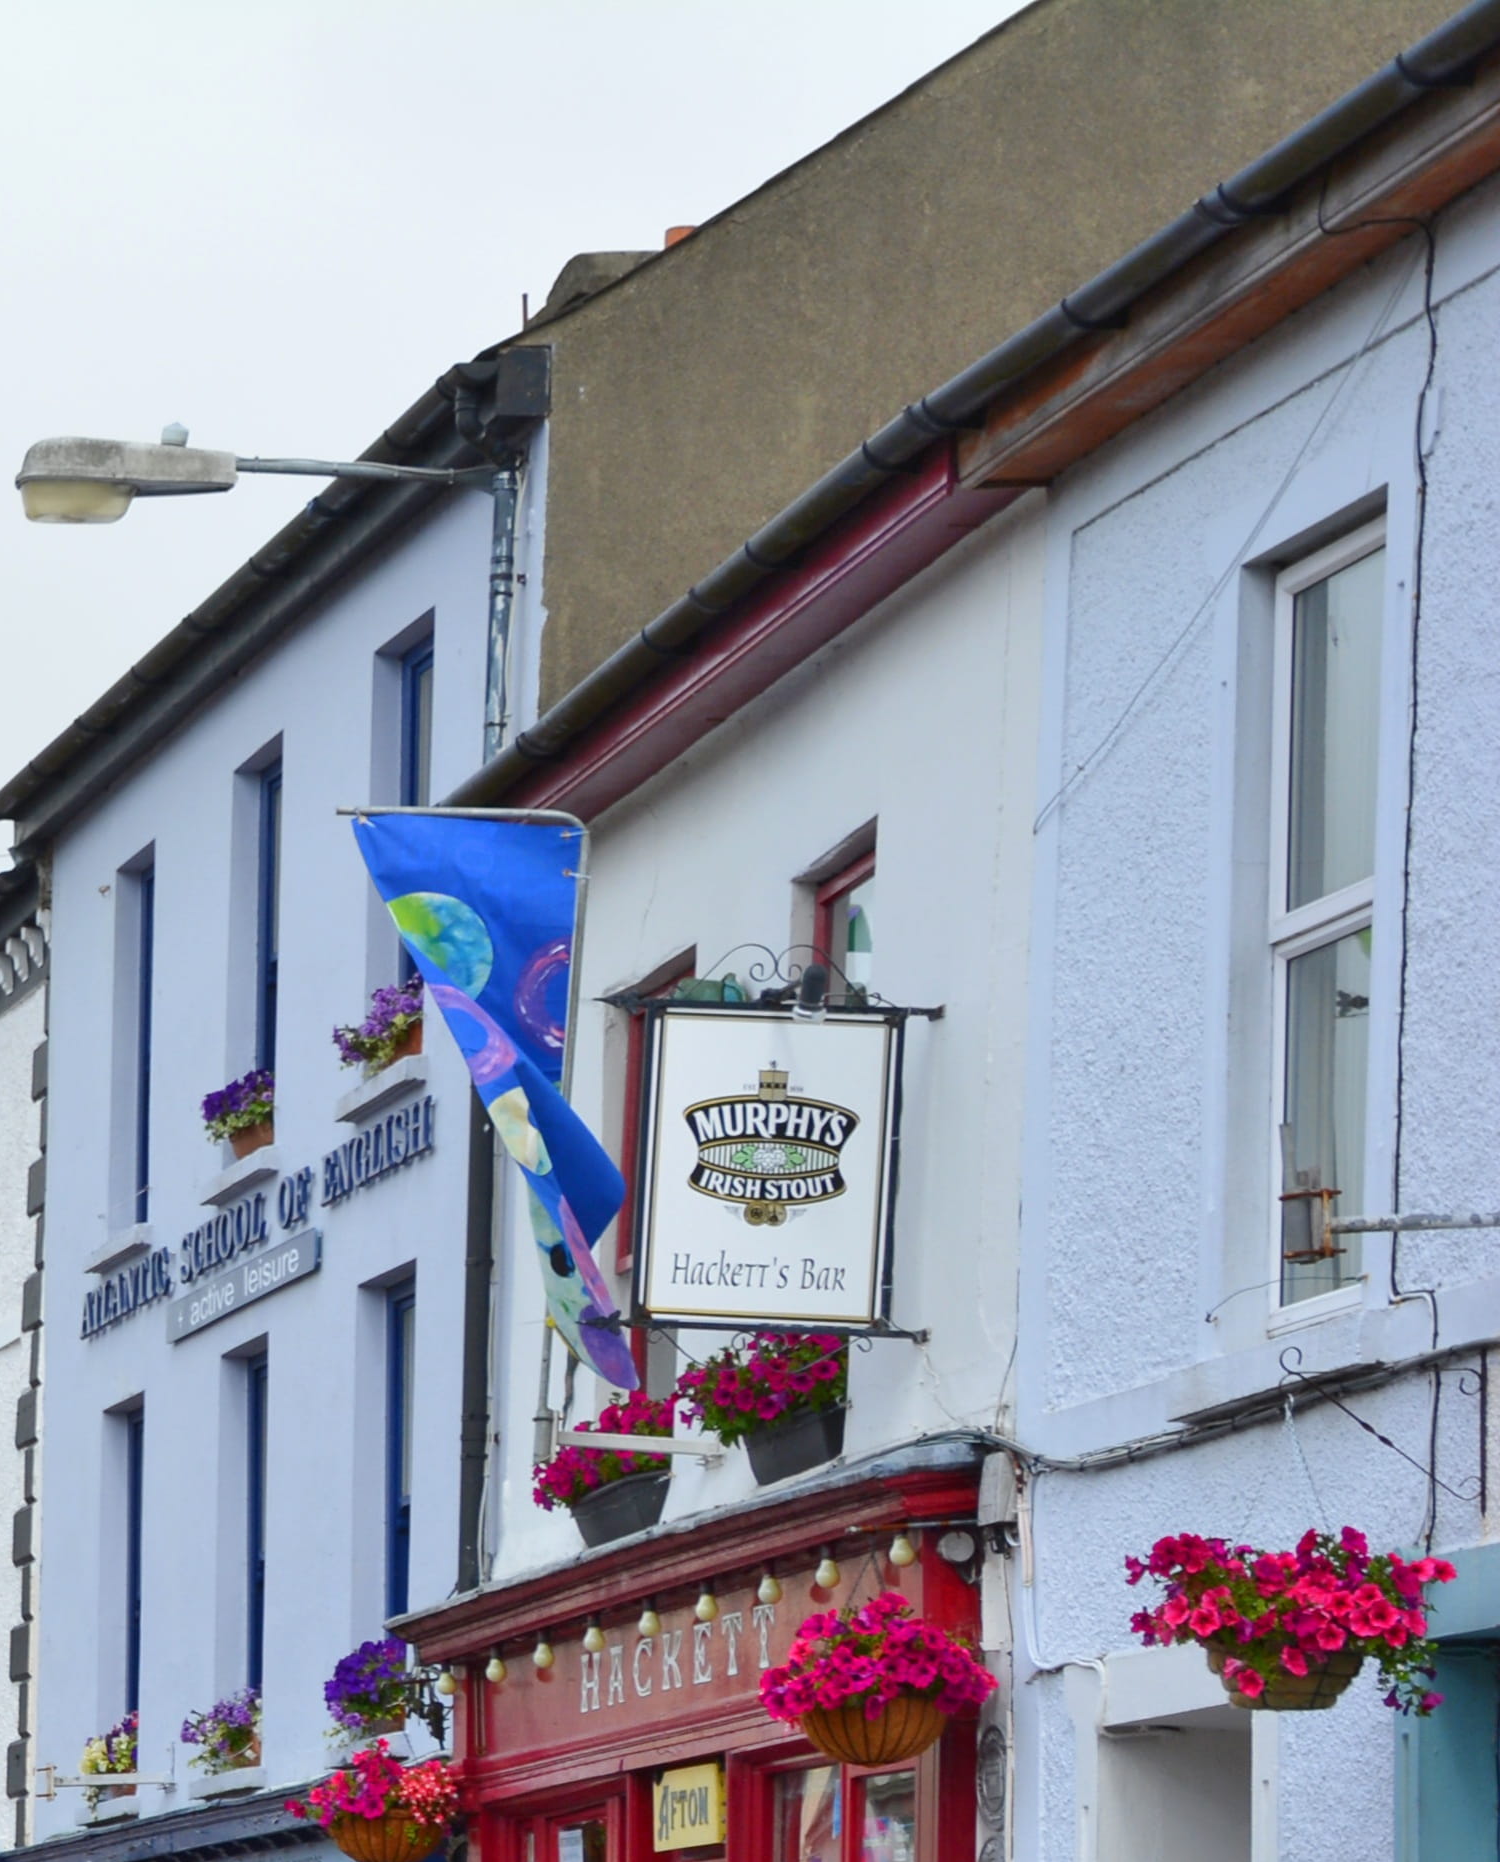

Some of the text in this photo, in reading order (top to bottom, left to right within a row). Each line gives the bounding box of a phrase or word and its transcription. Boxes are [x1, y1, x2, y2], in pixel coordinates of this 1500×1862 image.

[692, 1101, 848, 1147] MURPHY'S
[699, 1168, 835, 1200] IRISH STOUT
[80, 1094, 436, 1340] ATLANTIC SCHOOL OF ENGLISH
[190, 1279, 235, 1326] active
[243, 1246, 301, 1297] leisure
[800, 1257, 846, 1292] Bar
[658, 1785, 708, 1841] AFTON
